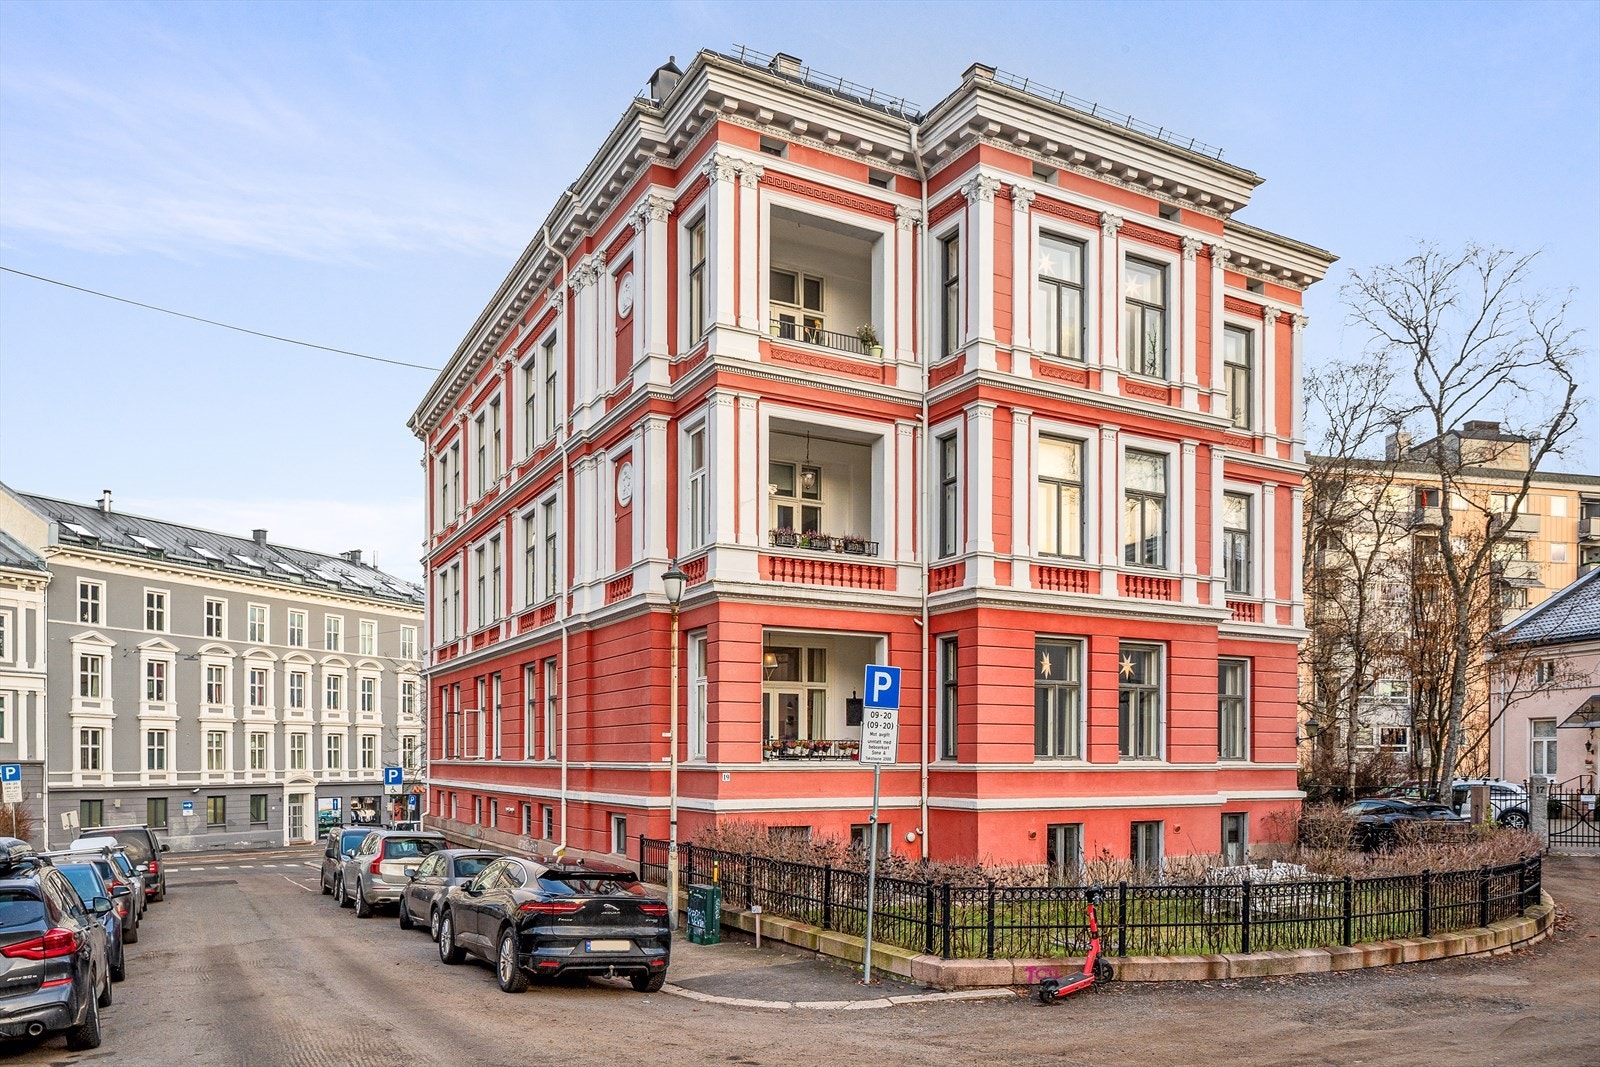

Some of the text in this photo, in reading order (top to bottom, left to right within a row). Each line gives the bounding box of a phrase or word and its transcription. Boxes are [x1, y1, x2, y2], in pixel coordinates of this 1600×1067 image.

[872, 671, 892, 702] P
[6, 767, 16, 780] P
[389, 770, 398, 782] P
